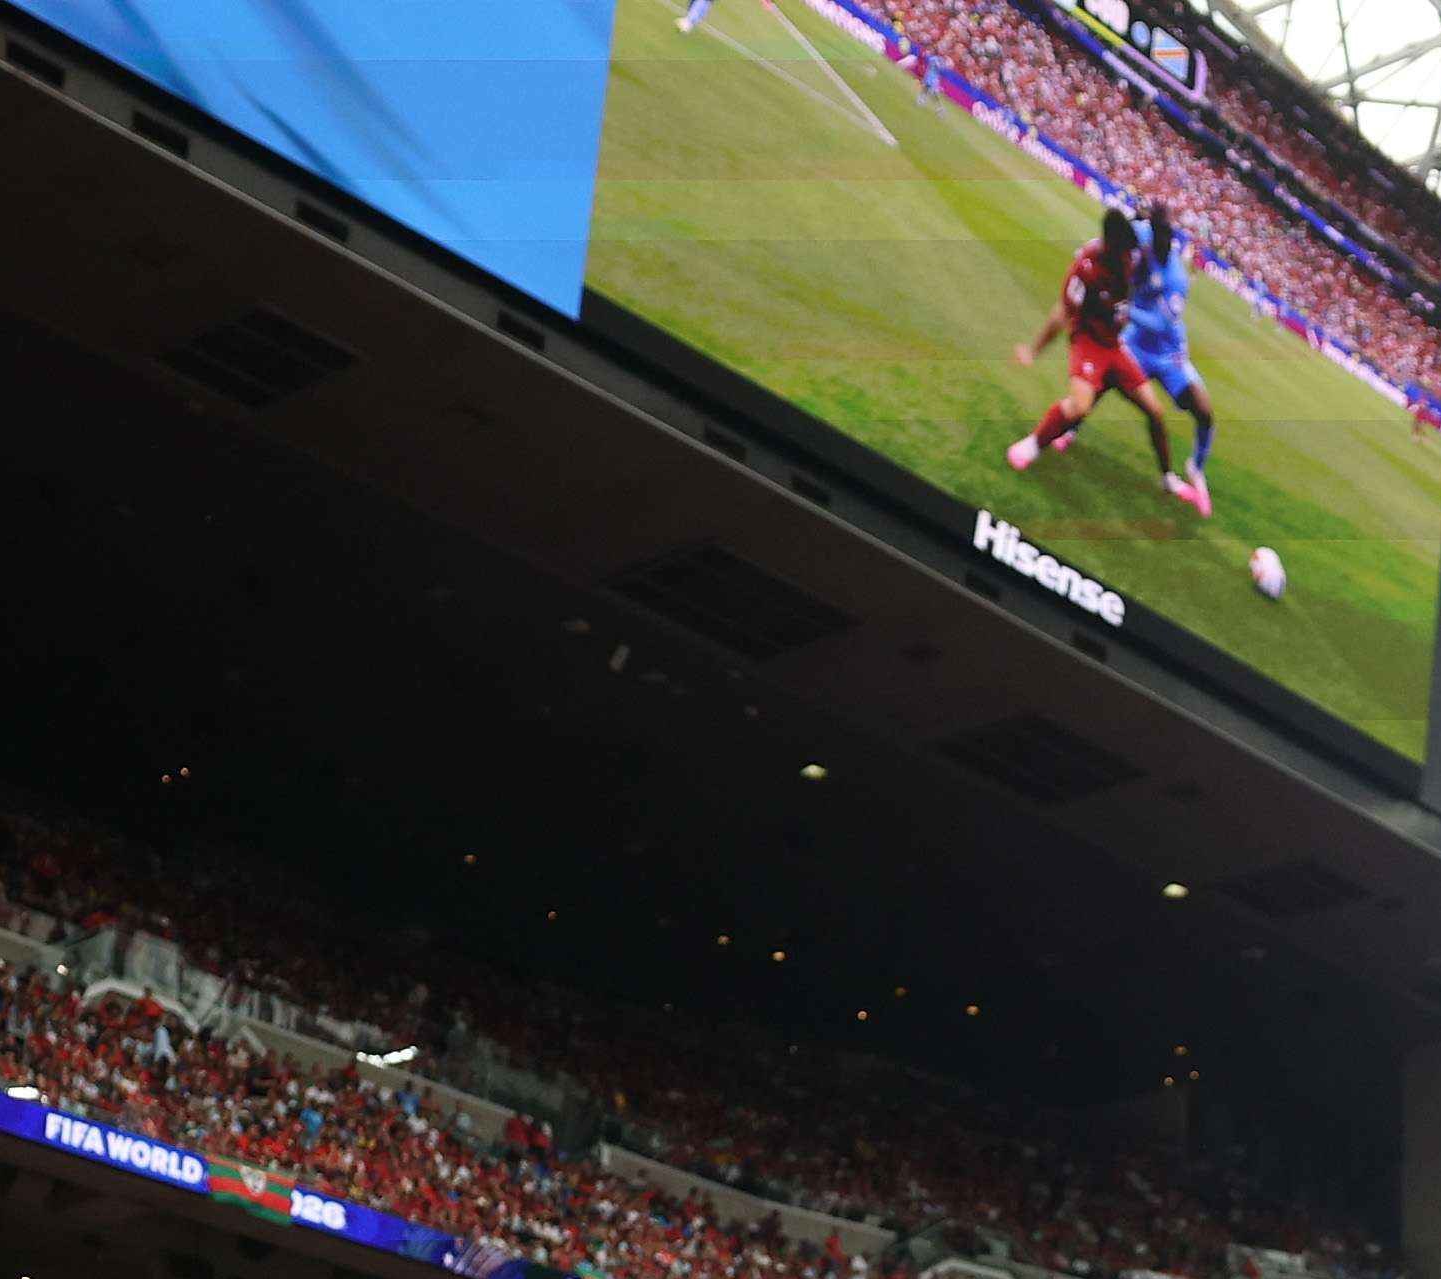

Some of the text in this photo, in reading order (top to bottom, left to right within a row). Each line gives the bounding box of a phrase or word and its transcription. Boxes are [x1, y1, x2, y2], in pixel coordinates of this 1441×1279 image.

[974, 509, 1126, 628] Hisense
[45, 1112, 105, 1156] FIFA
[106, 1130, 204, 1185] WORLD
